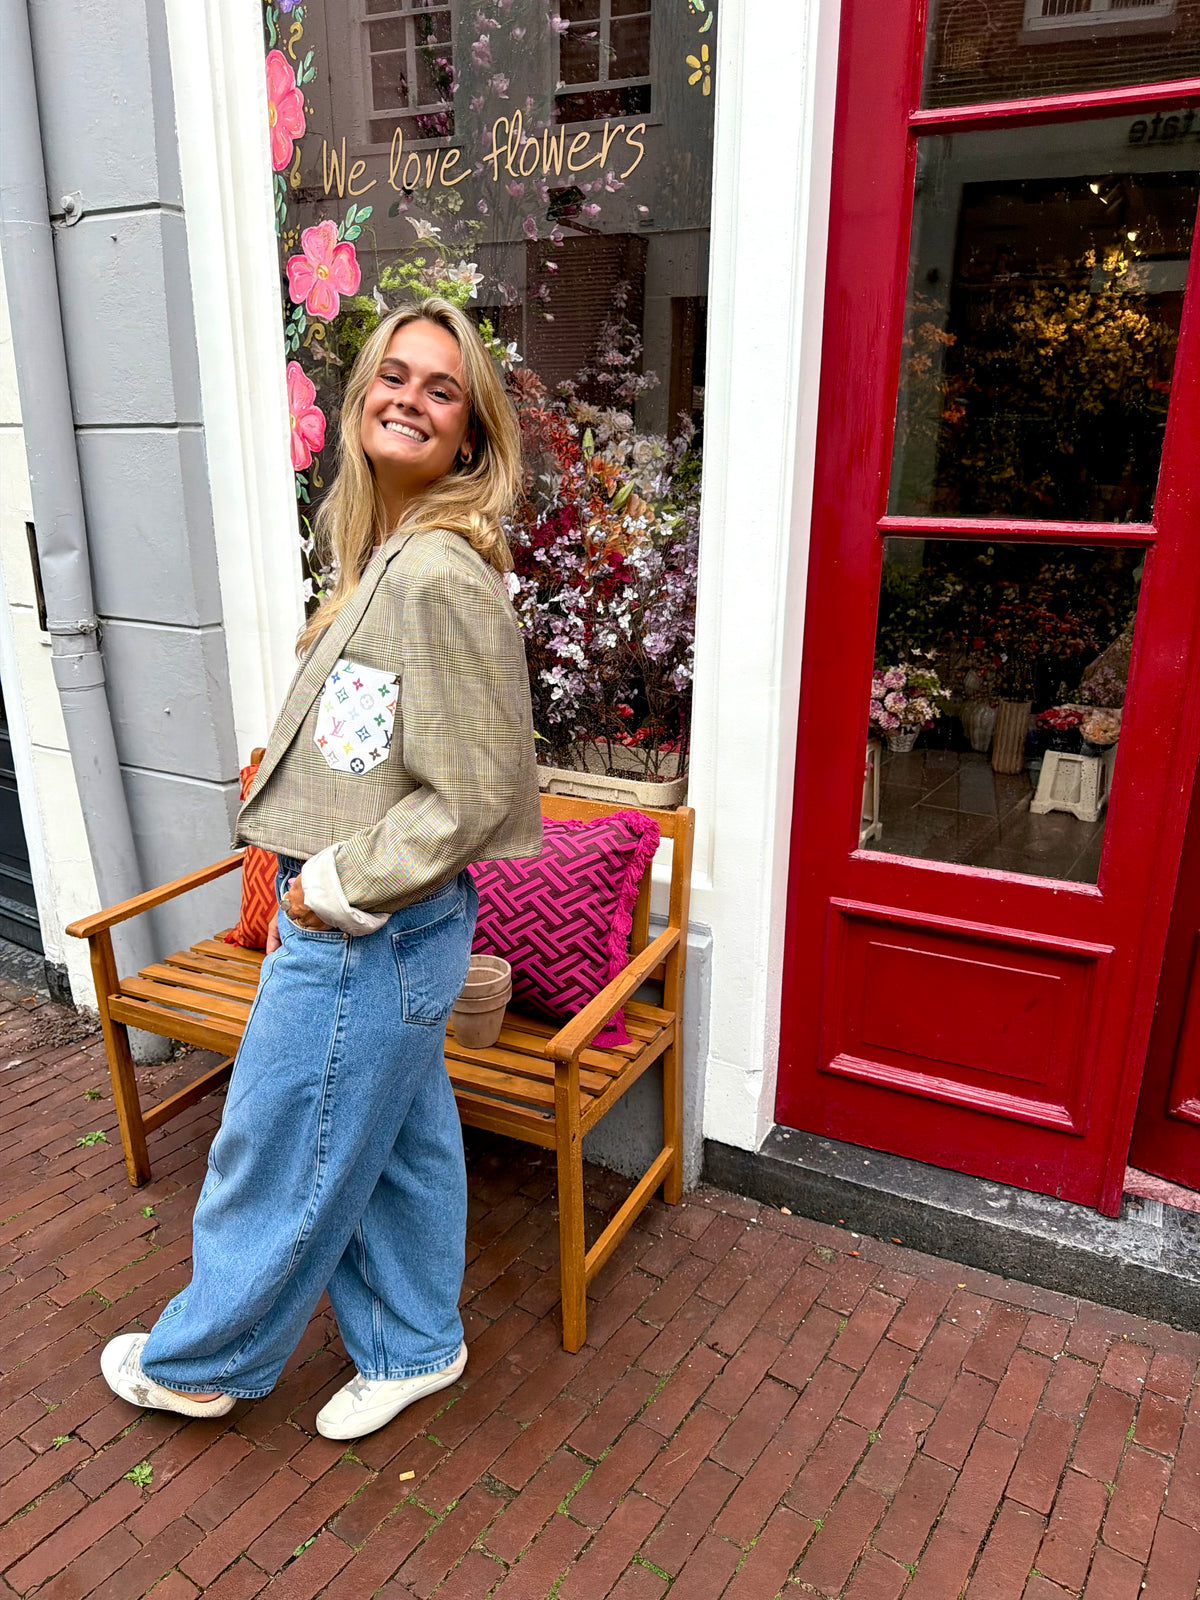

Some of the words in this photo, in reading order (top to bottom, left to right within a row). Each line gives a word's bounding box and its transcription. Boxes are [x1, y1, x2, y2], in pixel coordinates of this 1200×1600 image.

[322, 136, 377, 198] We
[387, 126, 473, 192] love
[482, 109, 647, 182] flowers
